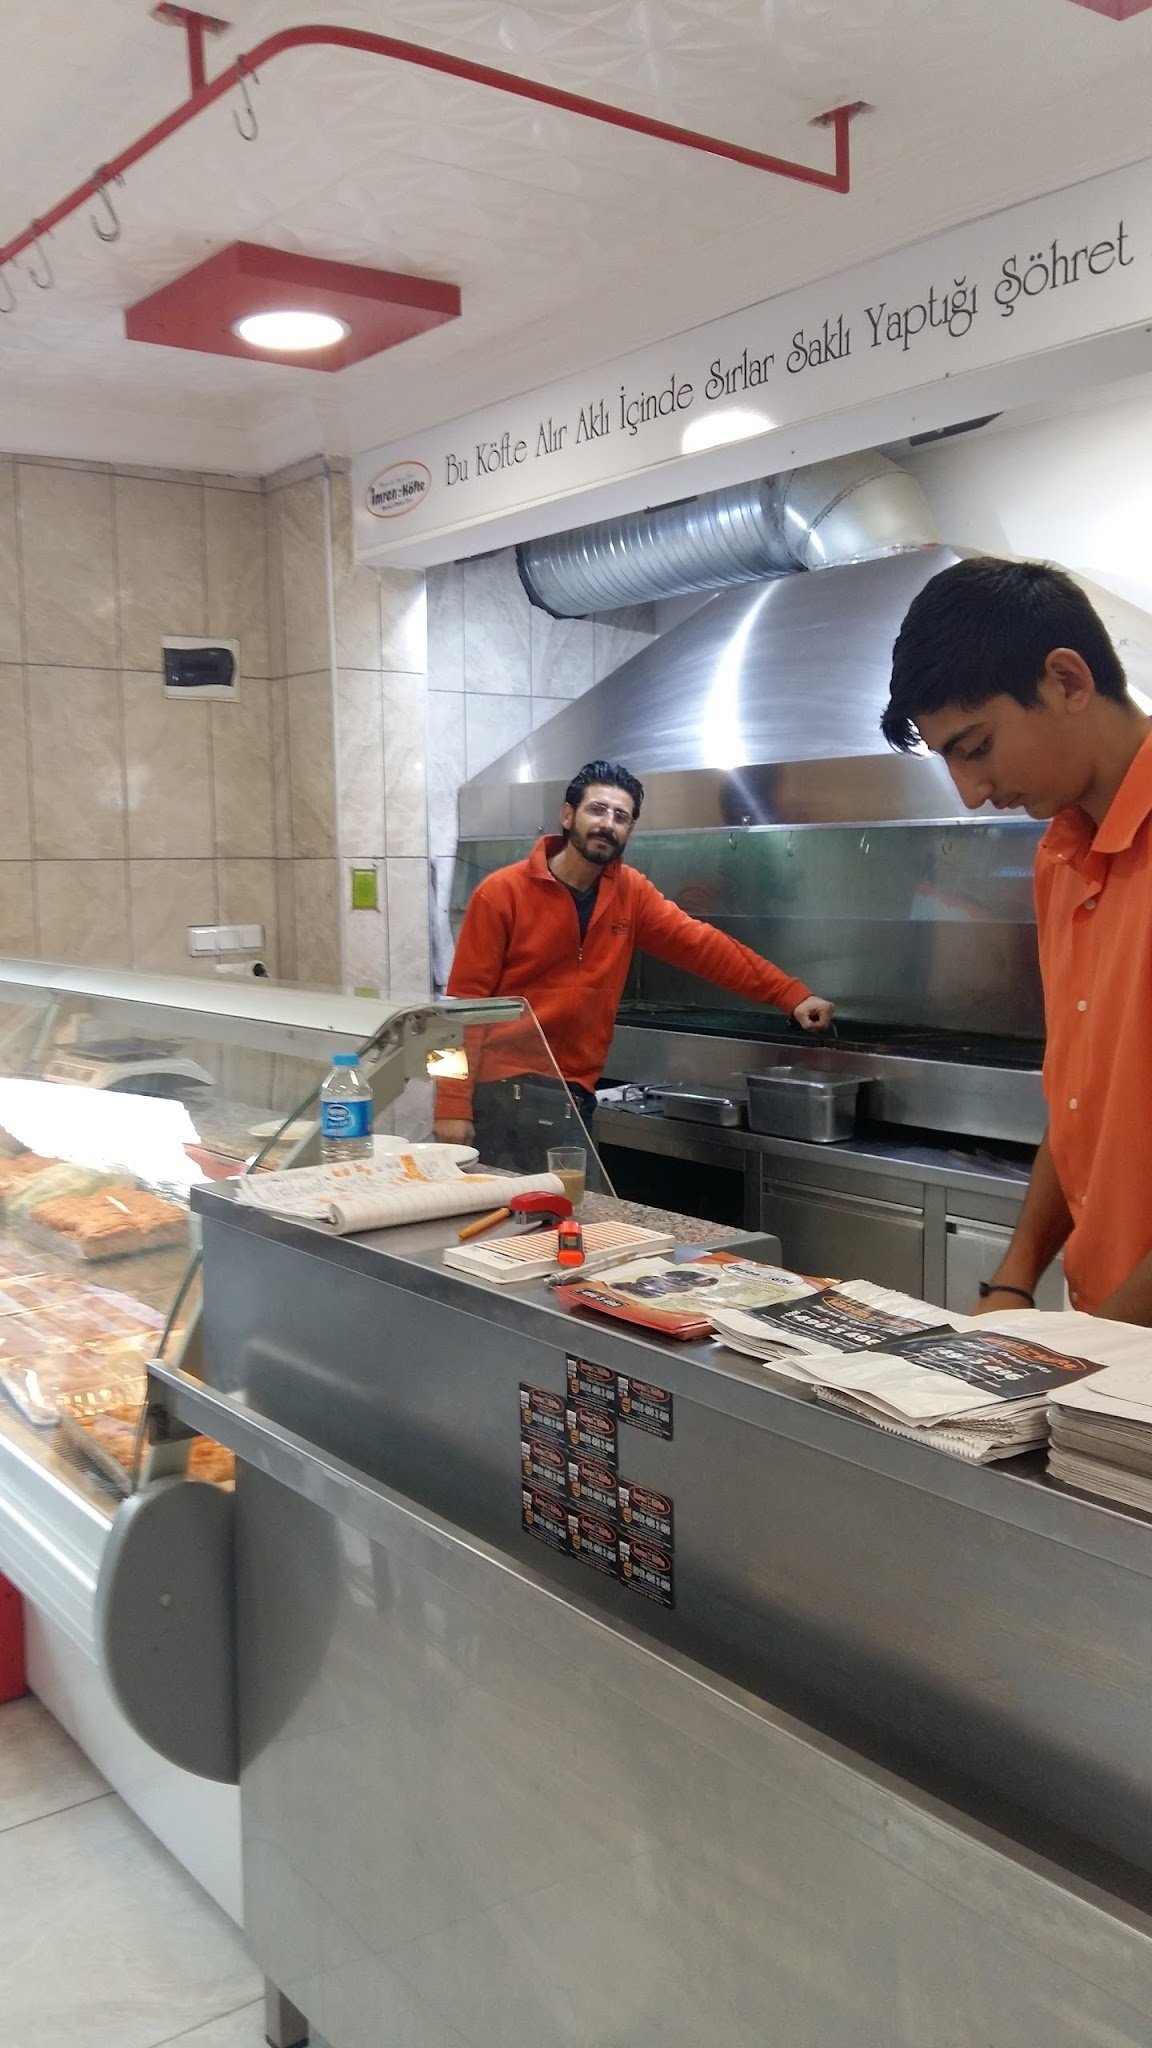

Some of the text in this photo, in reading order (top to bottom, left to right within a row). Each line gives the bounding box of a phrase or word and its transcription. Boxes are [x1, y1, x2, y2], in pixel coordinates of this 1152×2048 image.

[444, 220, 1135, 487] Bu Köfte Alır Aklı İçinde Sırlar Saklı Yaptığı Şöhret
